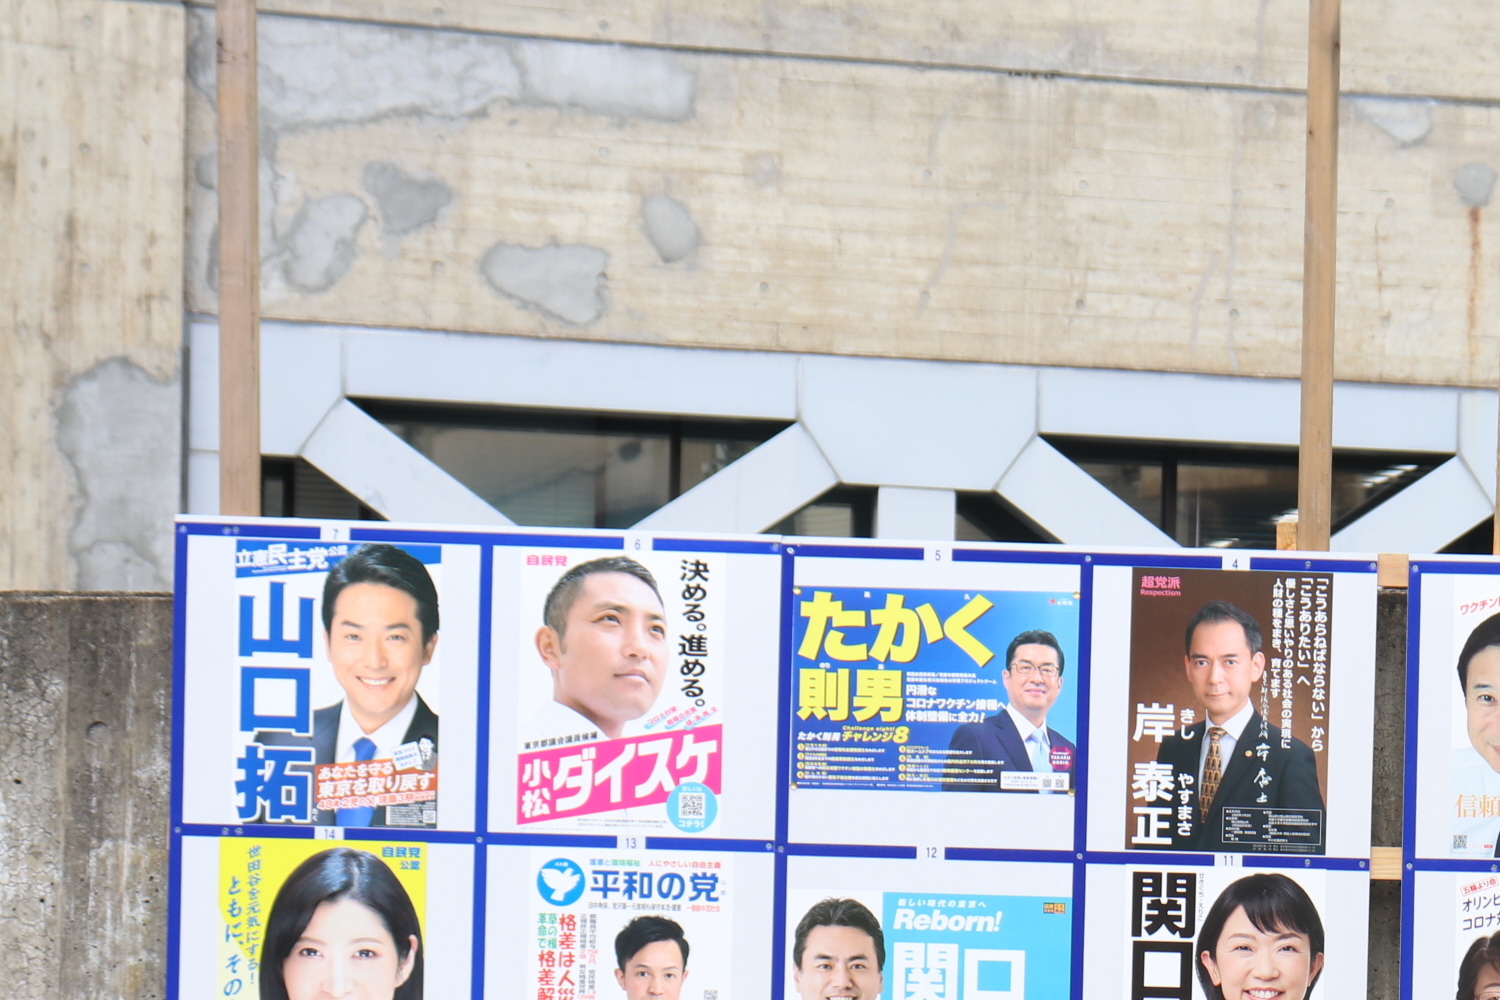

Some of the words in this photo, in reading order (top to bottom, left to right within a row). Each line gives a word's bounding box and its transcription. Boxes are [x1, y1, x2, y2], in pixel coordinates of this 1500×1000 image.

[332, 529, 339, 540] 7
[634, 539, 641, 550] 6
[526, 554, 568, 567] 自民党
[935, 550, 941, 561] 5
[1232, 559, 1239, 570] 4
[1141, 576, 1181, 589] 超党派
[1140, 588, 1182, 597] Respectism
[678, 558, 710, 708] 決める。進める。
[797, 590, 996, 668] たかく
[1270, 577, 1284, 699] 人財の種をまき、育てます
[1296, 577, 1314, 687] 「こうありたい」へ
[1280, 577, 1297, 749] 優しさと思いやりのある社会の実現に
[1310, 577, 1329, 751] 「こうあらねばならない」から
[796, 668, 905, 723] 則男
[905, 684, 938, 696] 円滑な
[235, 581, 315, 822] 山口拓
[905, 697, 1007, 711] コロナワクチン接種へ
[905, 711, 986, 723] 体制整備に全力！
[1179, 707, 1195, 741] きし
[523, 731, 598, 750] 東京都議会議員候補
[797, 731, 841, 742] たかく則男
[317, 761, 393, 780] あなたを守る
[552, 733, 718, 812] ダイスケ
[316, 773, 436, 798] 東京を取り戻す
[521, 758, 551, 819] 小松
[1131, 761, 1176, 846] 泰正
[1177, 772, 1194, 836] やすまさ
[324, 828, 336, 839] 14
[382, 846, 421, 858] 自民党
[625, 838, 637, 849] 13
[925, 847, 937, 858] 12
[399, 860, 420, 870] 公認
[648, 860, 722, 869] 人にやさしい自由主義
[1223, 856, 1234, 866] 11
[590, 870, 720, 902] 平和の党
[1463, 878, 1497, 895] 五輪より命
[897, 898, 987, 909] 新しい時代の東京へ
[246, 845, 262, 985] 世田谷を元気にする！
[893, 908, 1003, 933] Reborn!
[537, 912, 547, 949] 革命で
